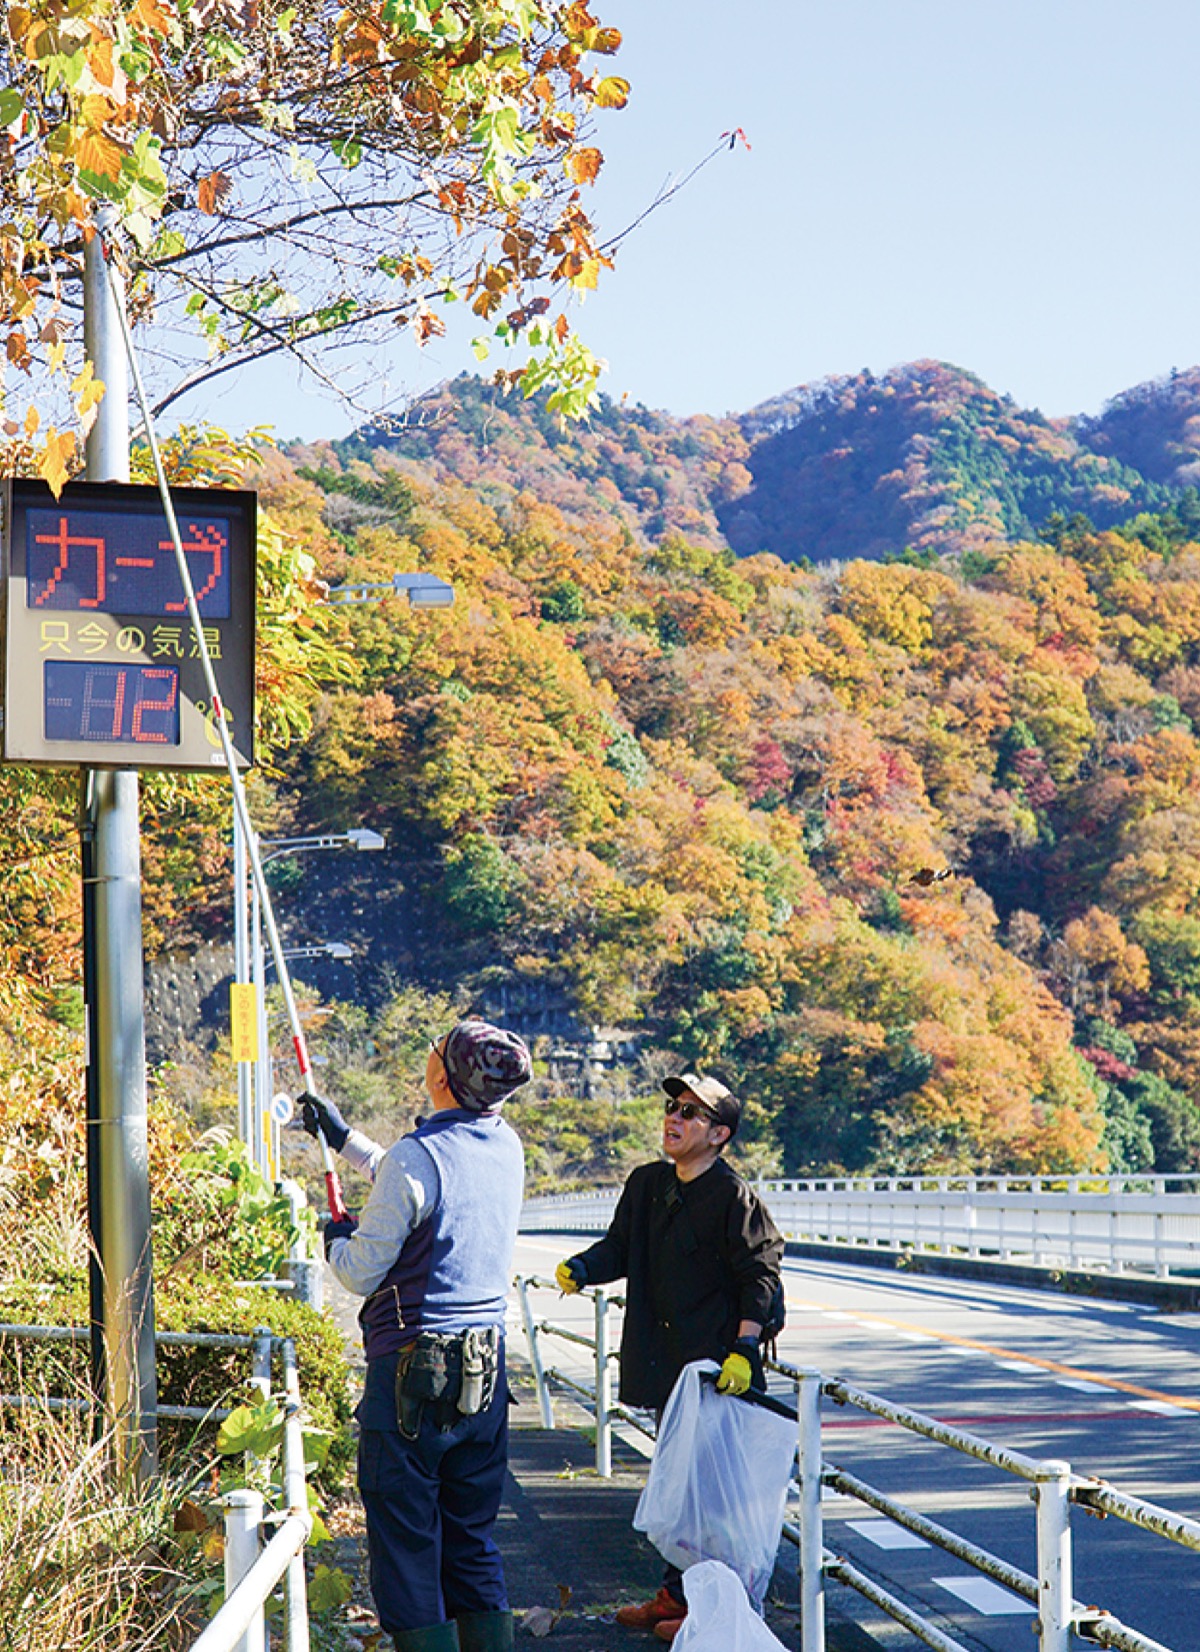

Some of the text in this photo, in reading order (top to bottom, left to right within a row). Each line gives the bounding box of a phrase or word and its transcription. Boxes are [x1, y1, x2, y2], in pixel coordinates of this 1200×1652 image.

[35, 517, 227, 611] カーブ
[39, 621, 223, 660] 只今の気温
[113, 669, 178, 743] 12
